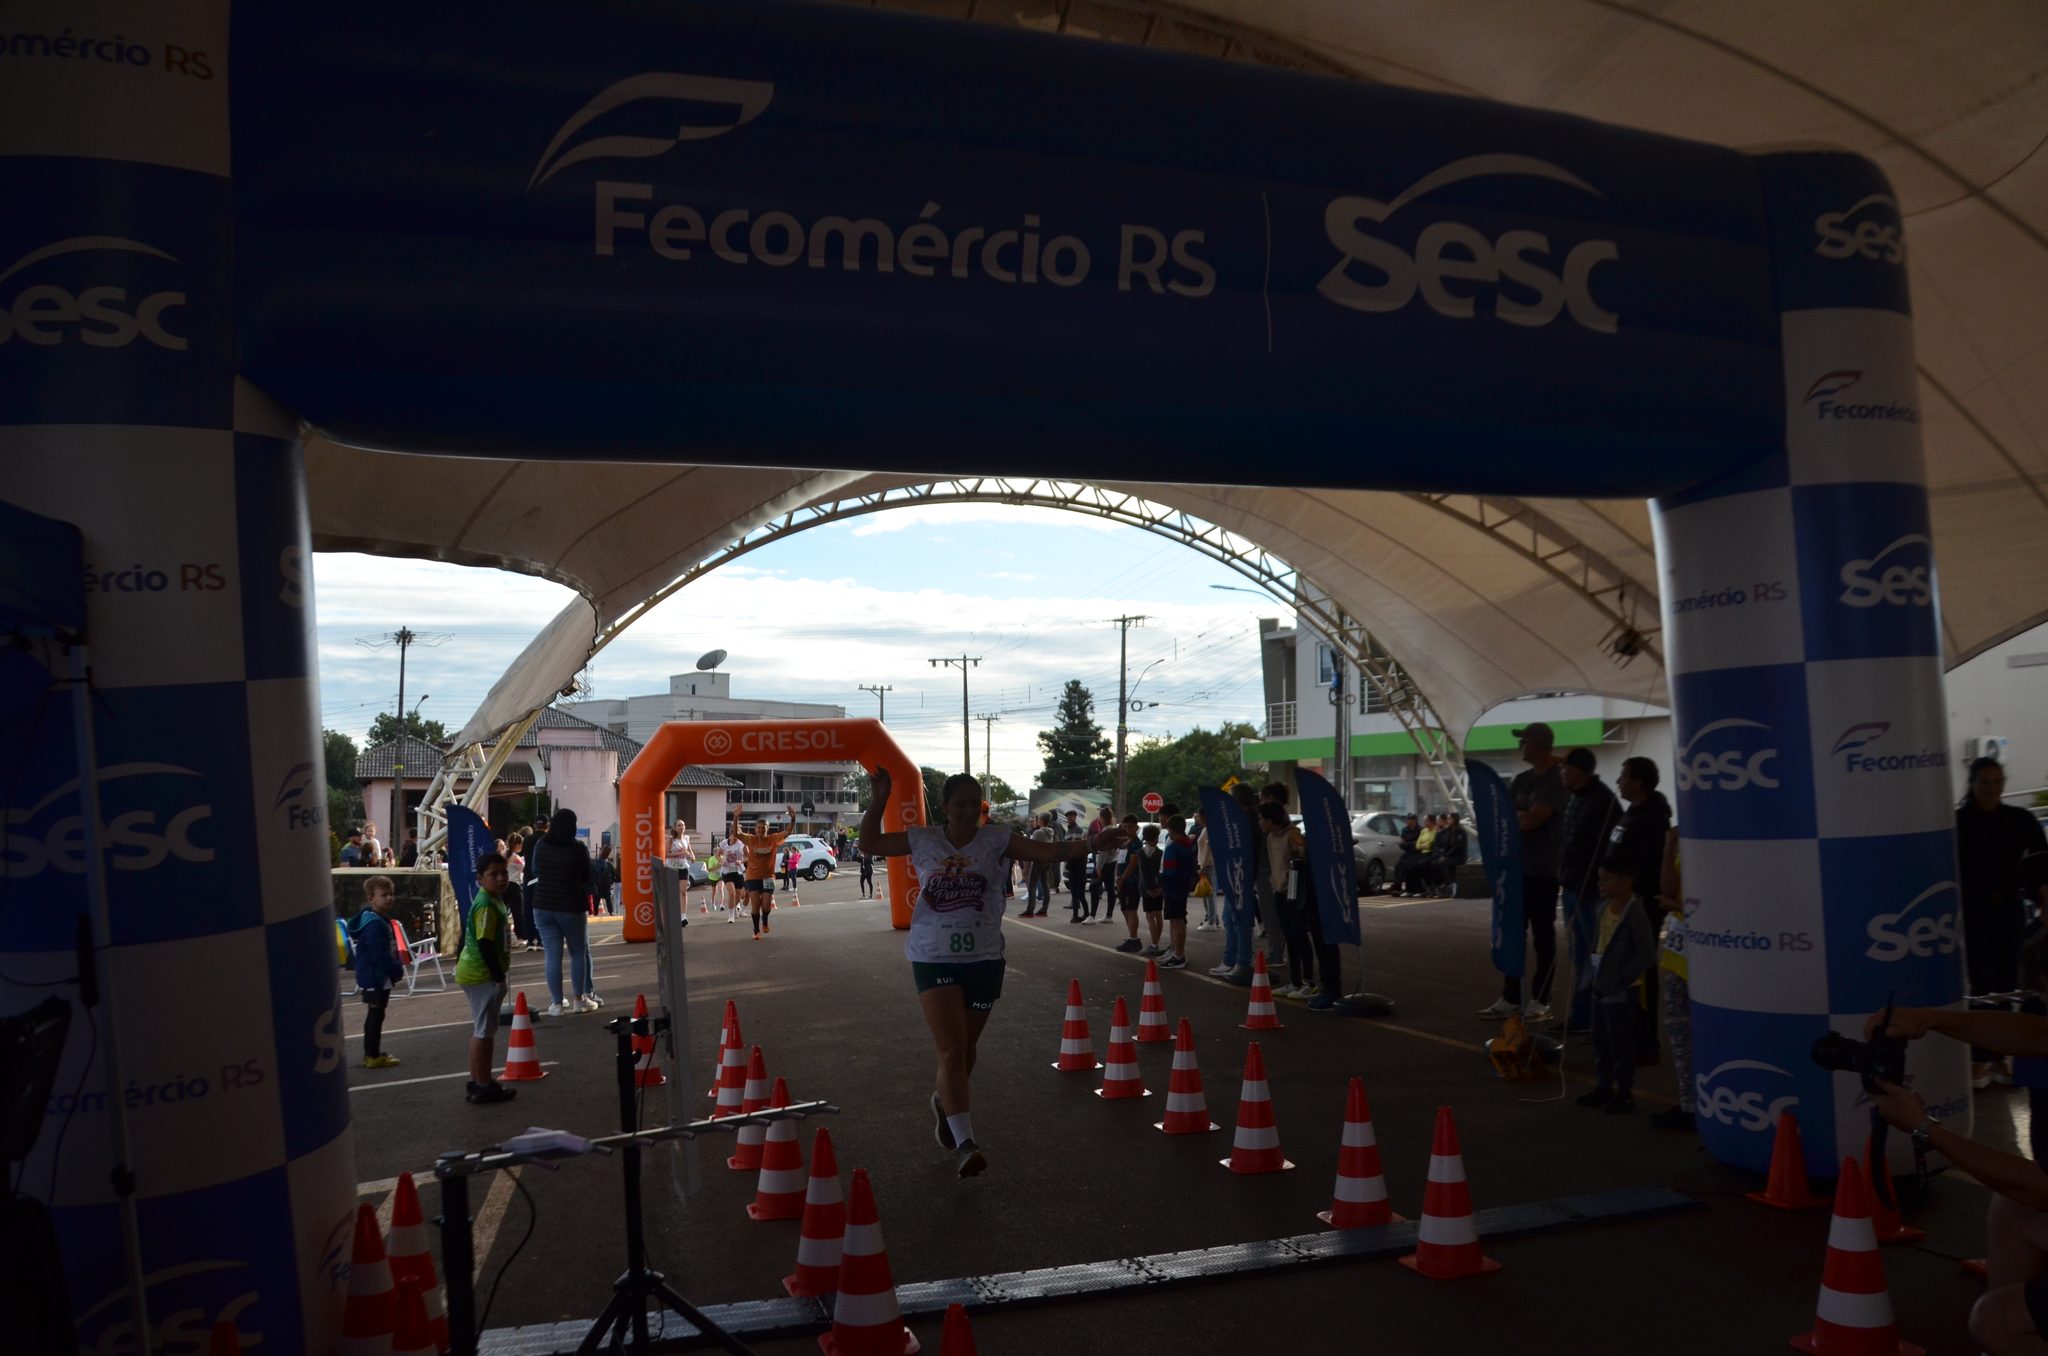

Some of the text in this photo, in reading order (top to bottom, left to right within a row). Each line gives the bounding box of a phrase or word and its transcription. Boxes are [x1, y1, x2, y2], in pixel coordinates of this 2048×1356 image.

[165, 44, 213, 80] RS
[595, 180, 1217, 297] Fecomércio RS
[1316, 195, 1620, 334] Sesc
[0, 284, 189, 351] esc
[180, 563, 226, 592] RS
[1753, 582, 1788, 602] RS
[741, 729, 845, 752] CRESOL
[1144, 799, 1161, 807] PARE
[635, 806, 653, 895] CRESOL
[950, 932, 976, 953] 89
[1778, 932, 1813, 952] RS
[220, 1059, 264, 1092] RS
